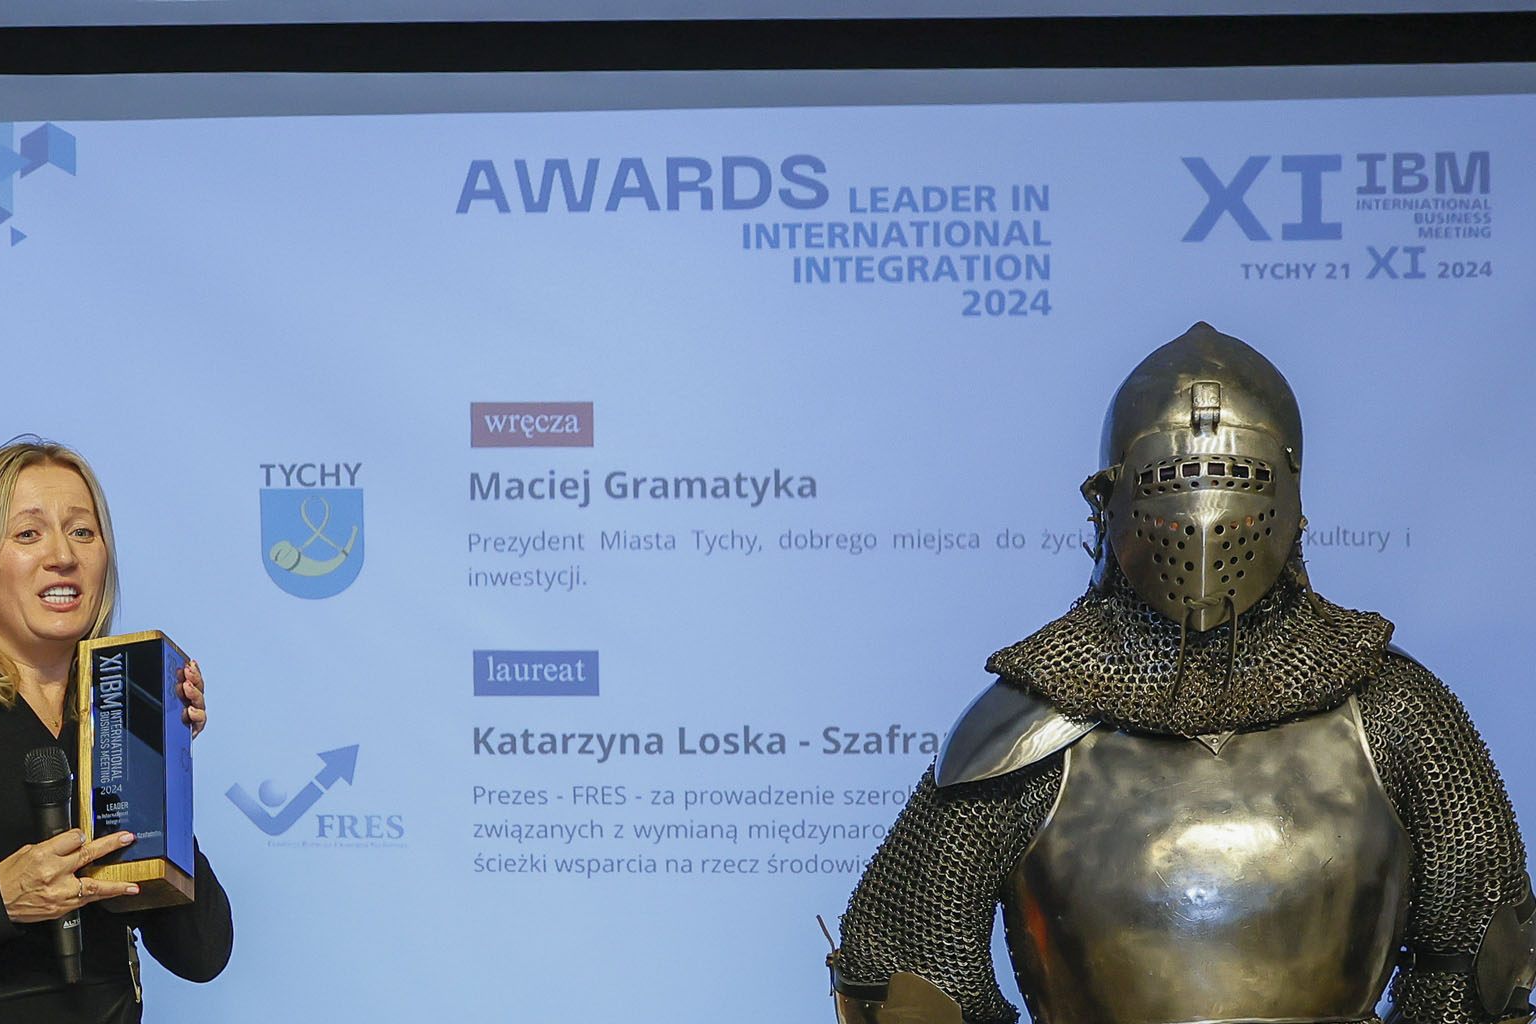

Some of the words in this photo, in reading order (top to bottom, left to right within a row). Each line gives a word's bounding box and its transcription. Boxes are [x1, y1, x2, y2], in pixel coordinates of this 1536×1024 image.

[456, 154, 829, 213] AWARDS
[1356, 151, 1491, 195] IBM
[848, 184, 998, 214] LEADER
[1011, 184, 1051, 212] IN
[1181, 154, 1342, 241] XI
[1413, 212, 1492, 225] BUSINESS
[1418, 226, 1492, 239] MEETING
[742, 220, 1052, 250] INTERNATIONAL
[793, 254, 1052, 284] INTEGRATION
[1240, 262, 1316, 280] TYCHY
[1325, 262, 1352, 280] 21
[1365, 246, 1427, 280] XI
[1437, 261, 1493, 279] 2024
[961, 289, 1053, 317] 2024
[483, 408, 581, 438] wręcza
[259, 462, 362, 488] TYCHY
[468, 470, 591, 508] Maciej
[604, 468, 818, 508] Gramatyka
[467, 530, 585, 558] Prezydent
[600, 529, 677, 551] Miasta
[691, 529, 763, 556] Tychy,
[778, 528, 878, 555] dobrego
[892, 527, 981, 554] miejsca
[995, 527, 1027, 549] do
[1306, 525, 1391, 554] kultury
[467, 565, 588, 592] inwestycji.
[99, 652, 123, 671] XI
[486, 656, 586, 683] laureat
[99, 673, 123, 710] IBM
[99, 710, 110, 750] BUSINESS
[472, 726, 664, 763] Katarzyna
[677, 724, 787, 756] Loska
[821, 723, 948, 755] Szafra
[110, 709, 123, 783] INTERNATIONAL
[99, 750, 111, 784] MEETING
[100, 784, 123, 796] 2024
[472, 785, 549, 806] Prezes
[571, 785, 626, 806] FRES
[650, 789, 676, 806] za
[683, 784, 835, 812] prowadzenie
[106, 801, 129, 812] LEADER
[316, 814, 405, 839] FRES
[472, 819, 604, 845] związanych
[613, 824, 625, 840] z
[633, 820, 739, 846] wymianą
[747, 818, 892, 844] międzynaro
[472, 853, 548, 874] ścieżki
[553, 853, 657, 879] wsparcia
[664, 858, 693, 874] na
[700, 857, 761, 875] rzecz
